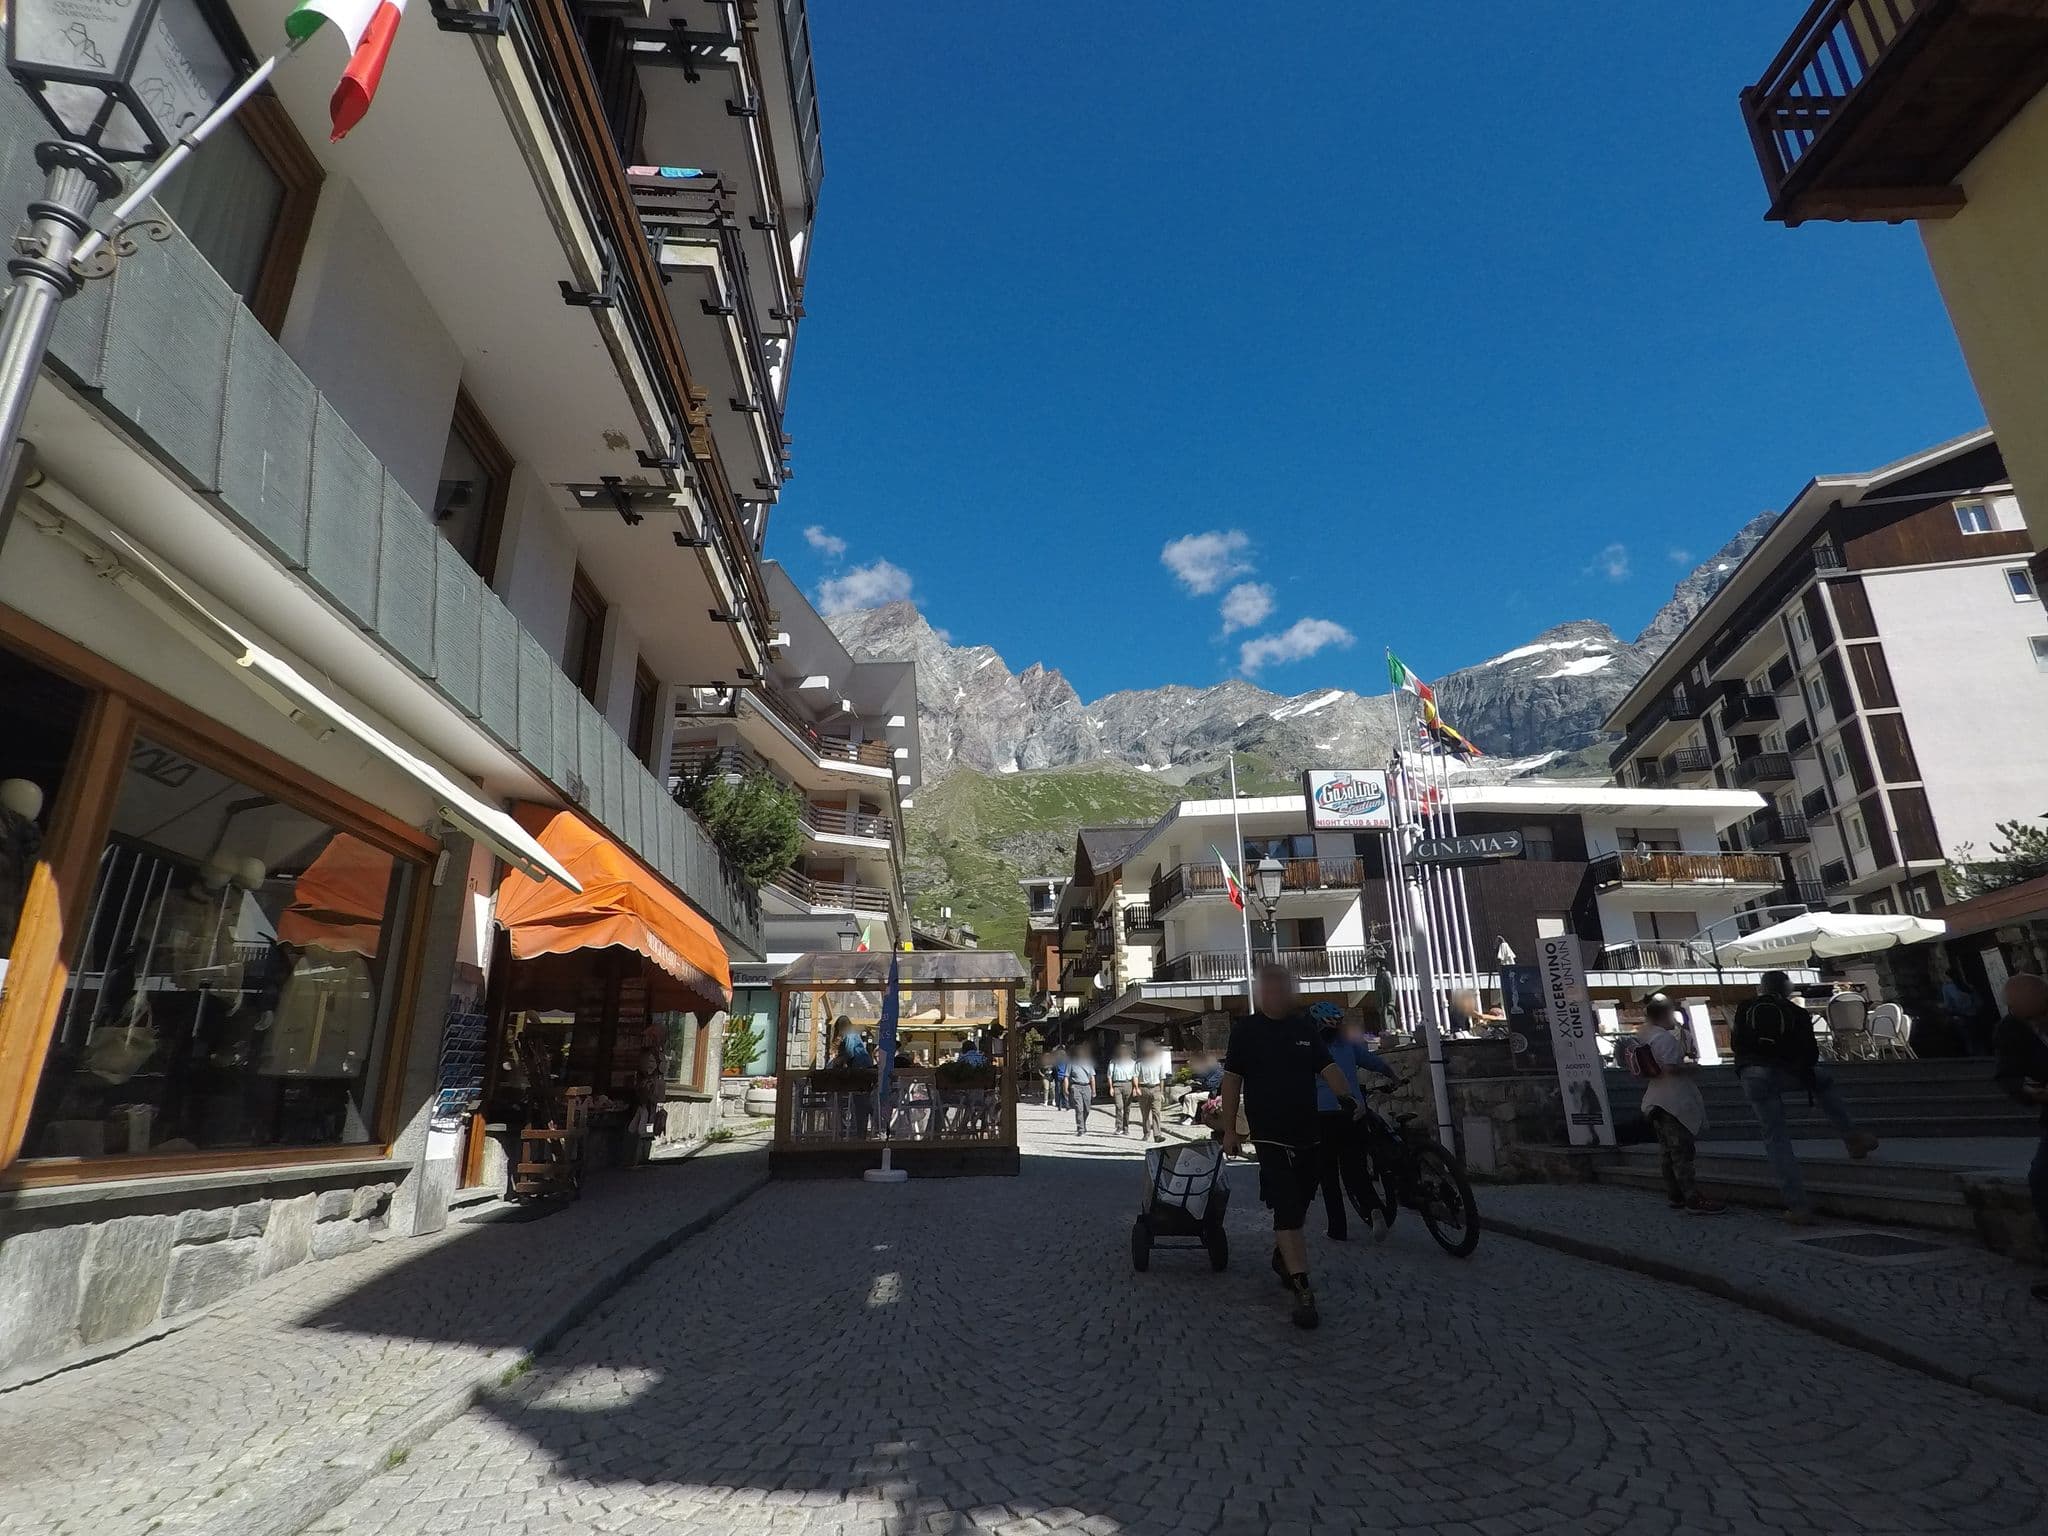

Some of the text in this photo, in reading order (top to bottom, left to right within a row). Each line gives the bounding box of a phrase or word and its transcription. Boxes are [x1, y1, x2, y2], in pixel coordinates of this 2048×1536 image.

[1322, 781, 1378, 803] Gasoline
[1316, 819, 1340, 827] NIGHT
[1343, 819, 1363, 827] CLUB
[1373, 819, 1390, 827] BAR
[1418, 838, 1501, 857] CINEMA
